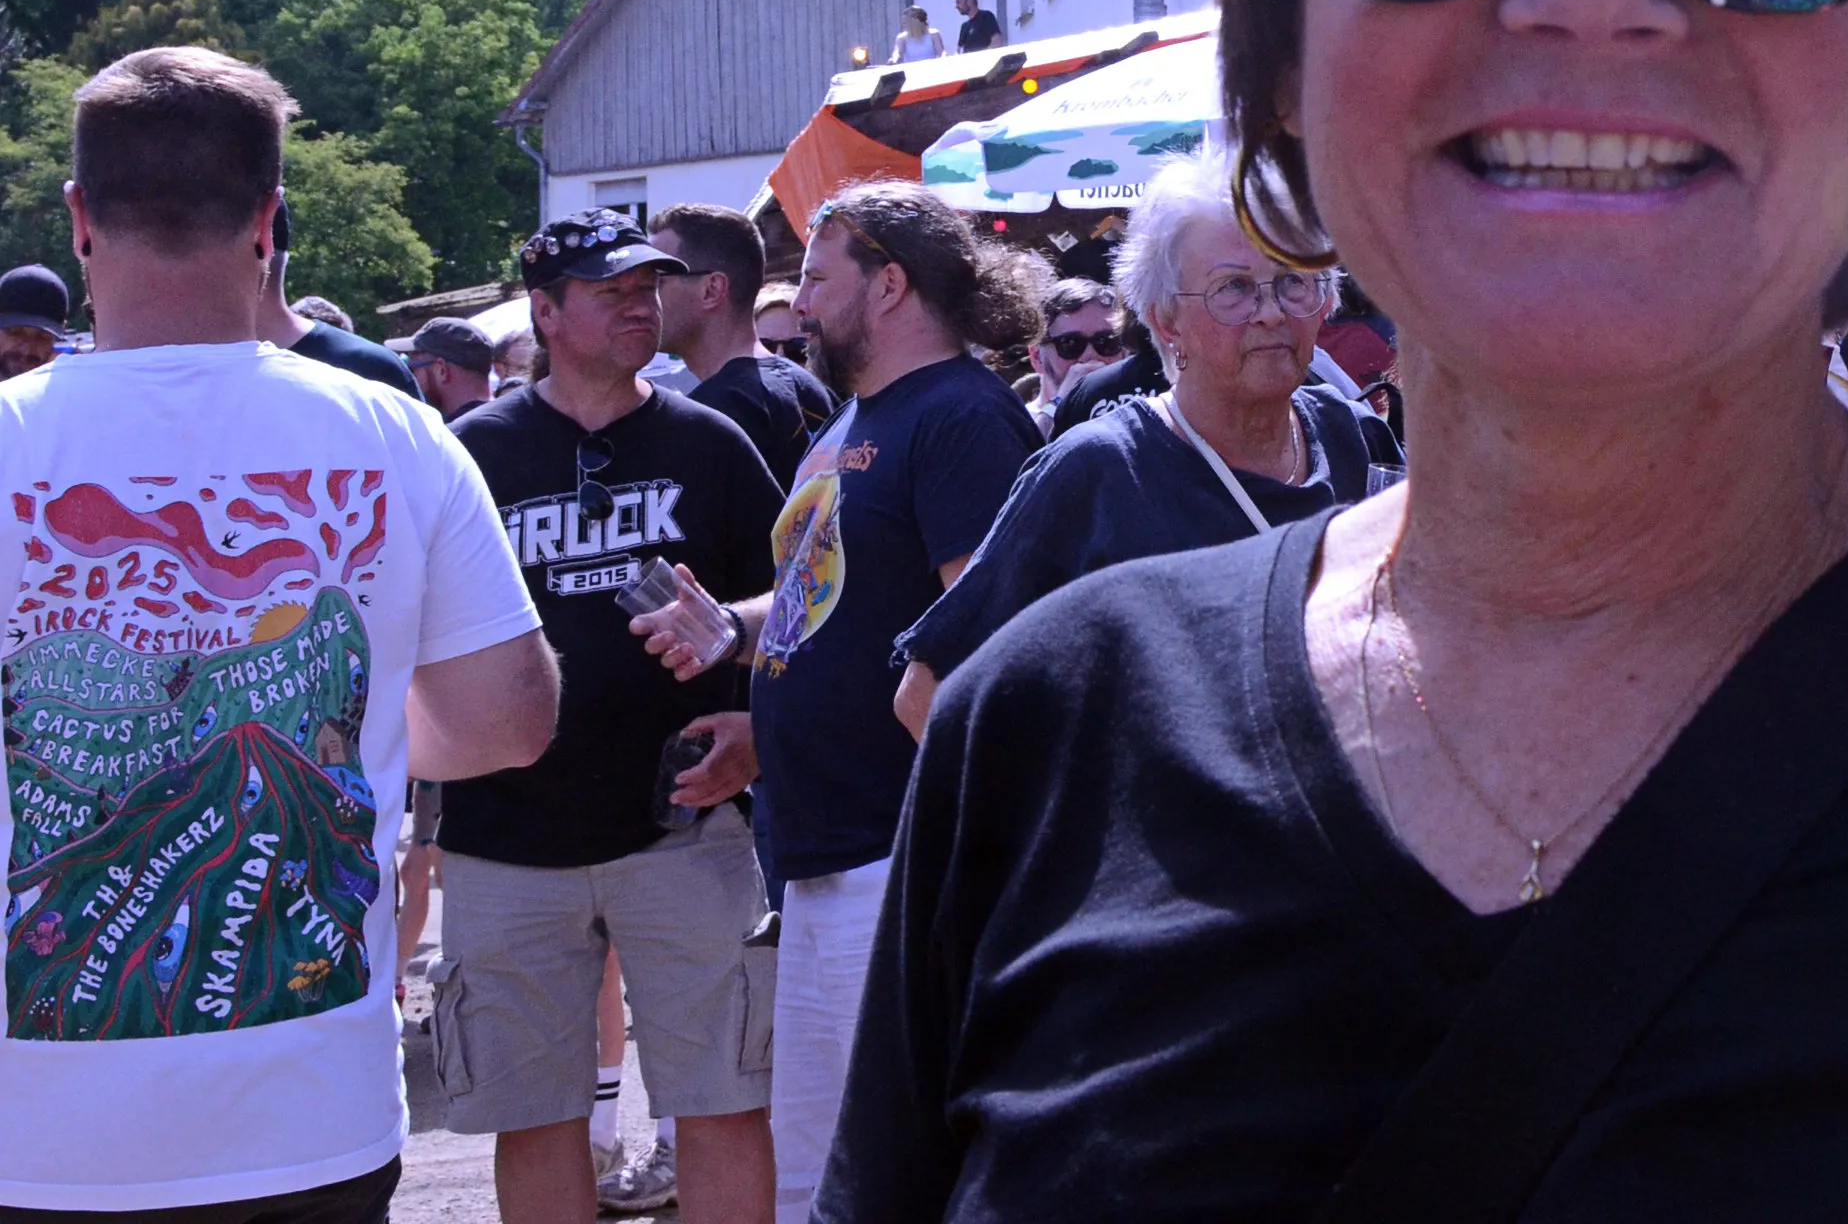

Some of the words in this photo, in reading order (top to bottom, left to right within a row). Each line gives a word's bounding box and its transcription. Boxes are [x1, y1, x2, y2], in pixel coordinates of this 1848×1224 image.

[39, 551, 180, 600] 2025
[574, 566, 628, 589] 2015
[34, 606, 113, 635] IROCK
[28, 641, 157, 677] IMMECKE
[208, 647, 288, 693] THOSE
[297, 610, 350, 661] MADE
[30, 670, 157, 702] ALLSTARS
[248, 652, 330, 714] BROKEN
[32, 709, 134, 744] CACTUS
[147, 706, 184, 736] FOR
[42, 736, 182, 778] BREAKFAST
[15, 779, 92, 827] ADAMS
[22, 807, 63, 838] FALL
[72, 954, 109, 1004] THE
[97, 806, 226, 955] BONESHAKERZ
[194, 832, 281, 1019] SKAMPIDA
